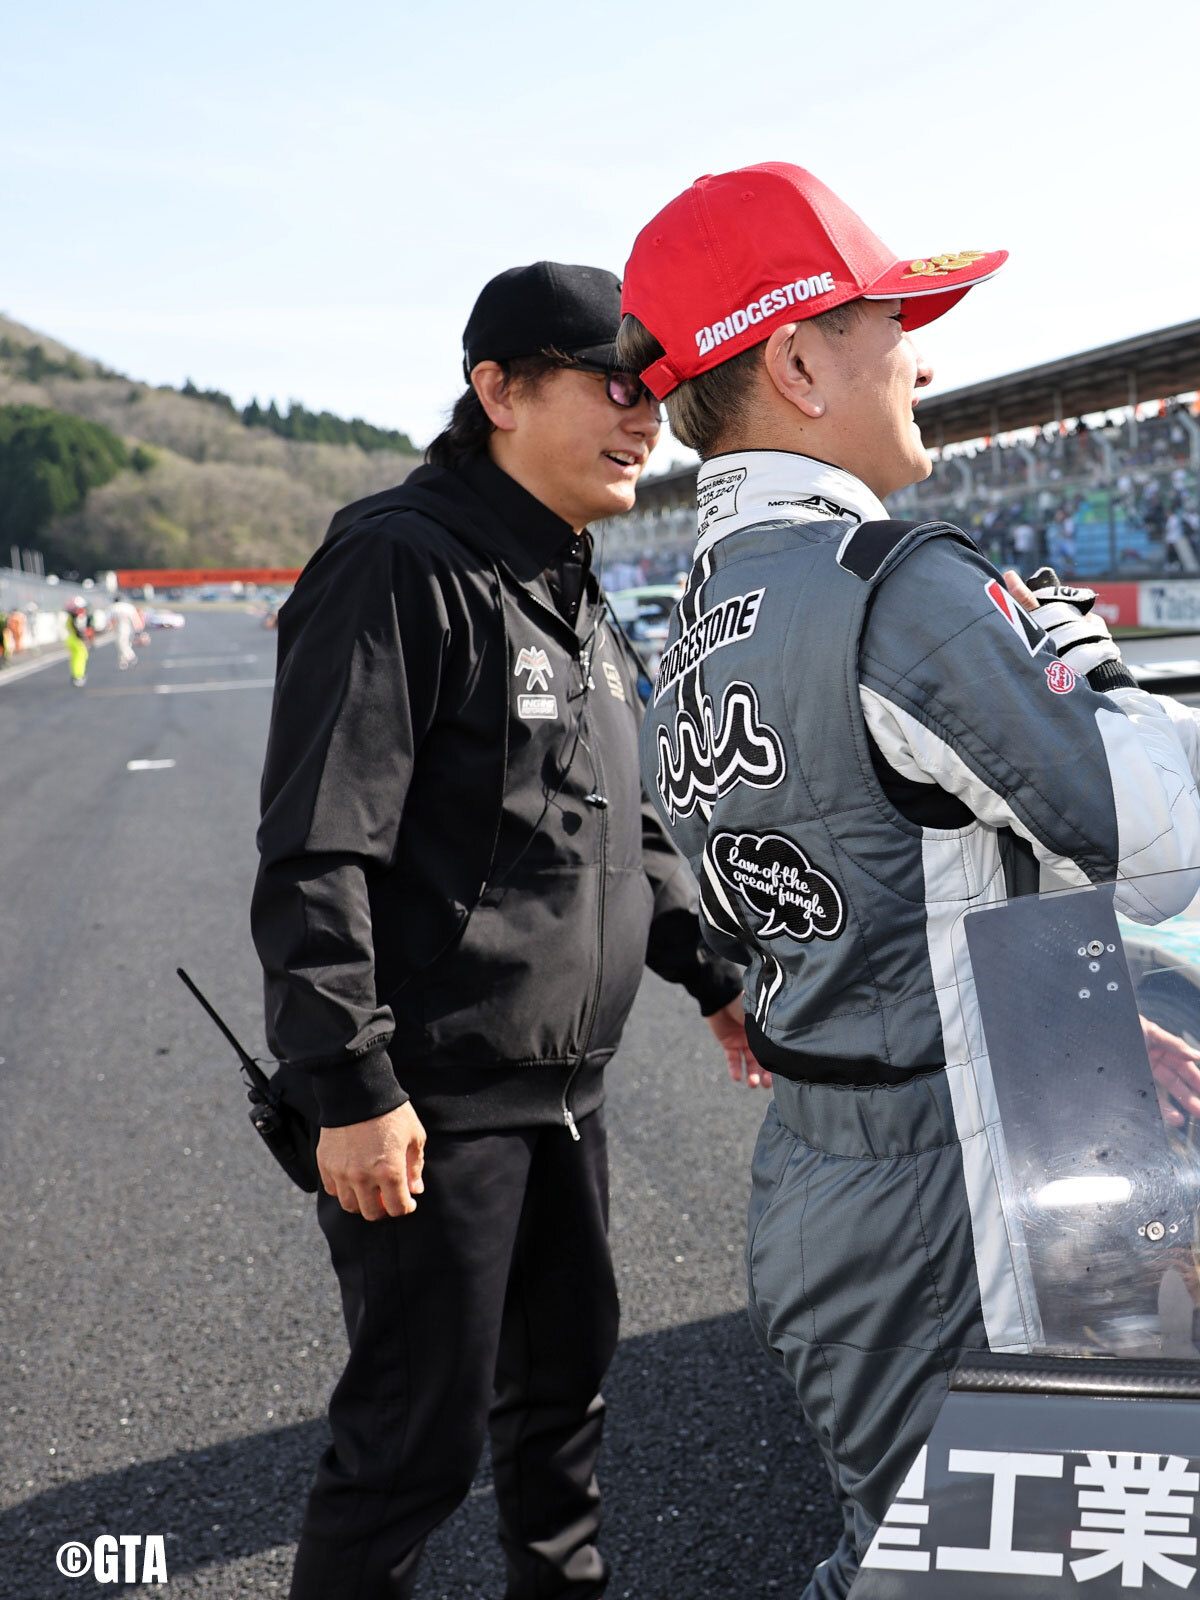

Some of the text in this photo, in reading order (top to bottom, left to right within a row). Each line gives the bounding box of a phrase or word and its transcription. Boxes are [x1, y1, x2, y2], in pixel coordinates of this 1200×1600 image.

[695, 271, 836, 357] BRIDGESTONE
[733, 870, 827, 920] ocean jungle
[762, 861, 782, 889] of
[779, 865, 811, 894] the
